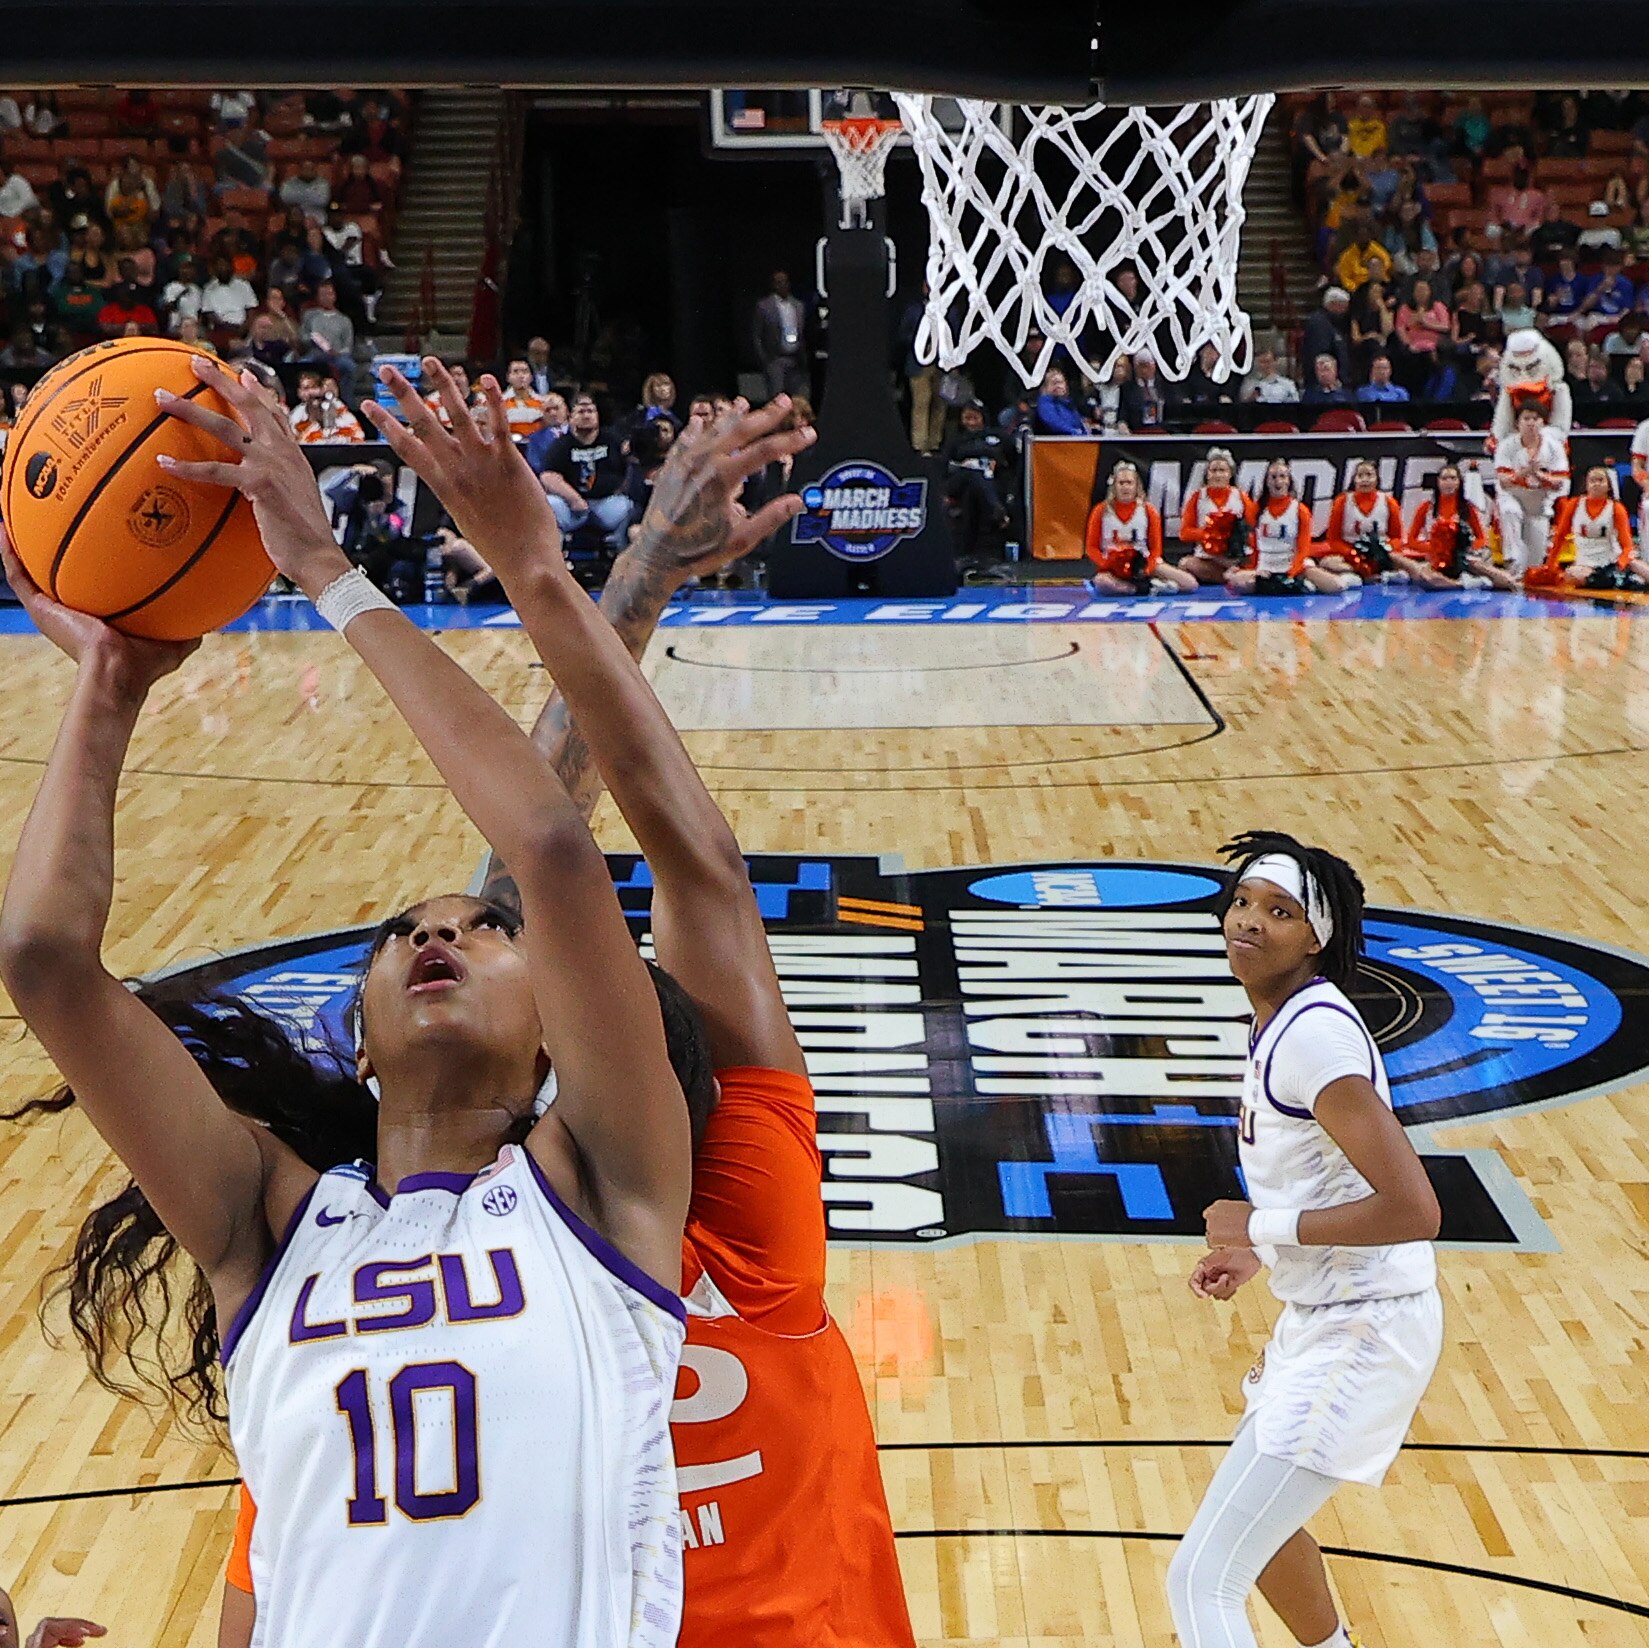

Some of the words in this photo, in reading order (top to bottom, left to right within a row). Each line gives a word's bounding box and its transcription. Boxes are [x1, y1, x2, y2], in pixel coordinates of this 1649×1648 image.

[822, 487, 891, 509] MARCH
[830, 507, 922, 530] MADNESS
[863, 600, 1246, 619] EIGHT
[1388, 943, 1589, 1008] SWEET
[948, 908, 1252, 1098] MARCH
[483, 1187, 517, 1215] SEC
[289, 1248, 527, 1346] LSU
[335, 1360, 482, 1528] 10
